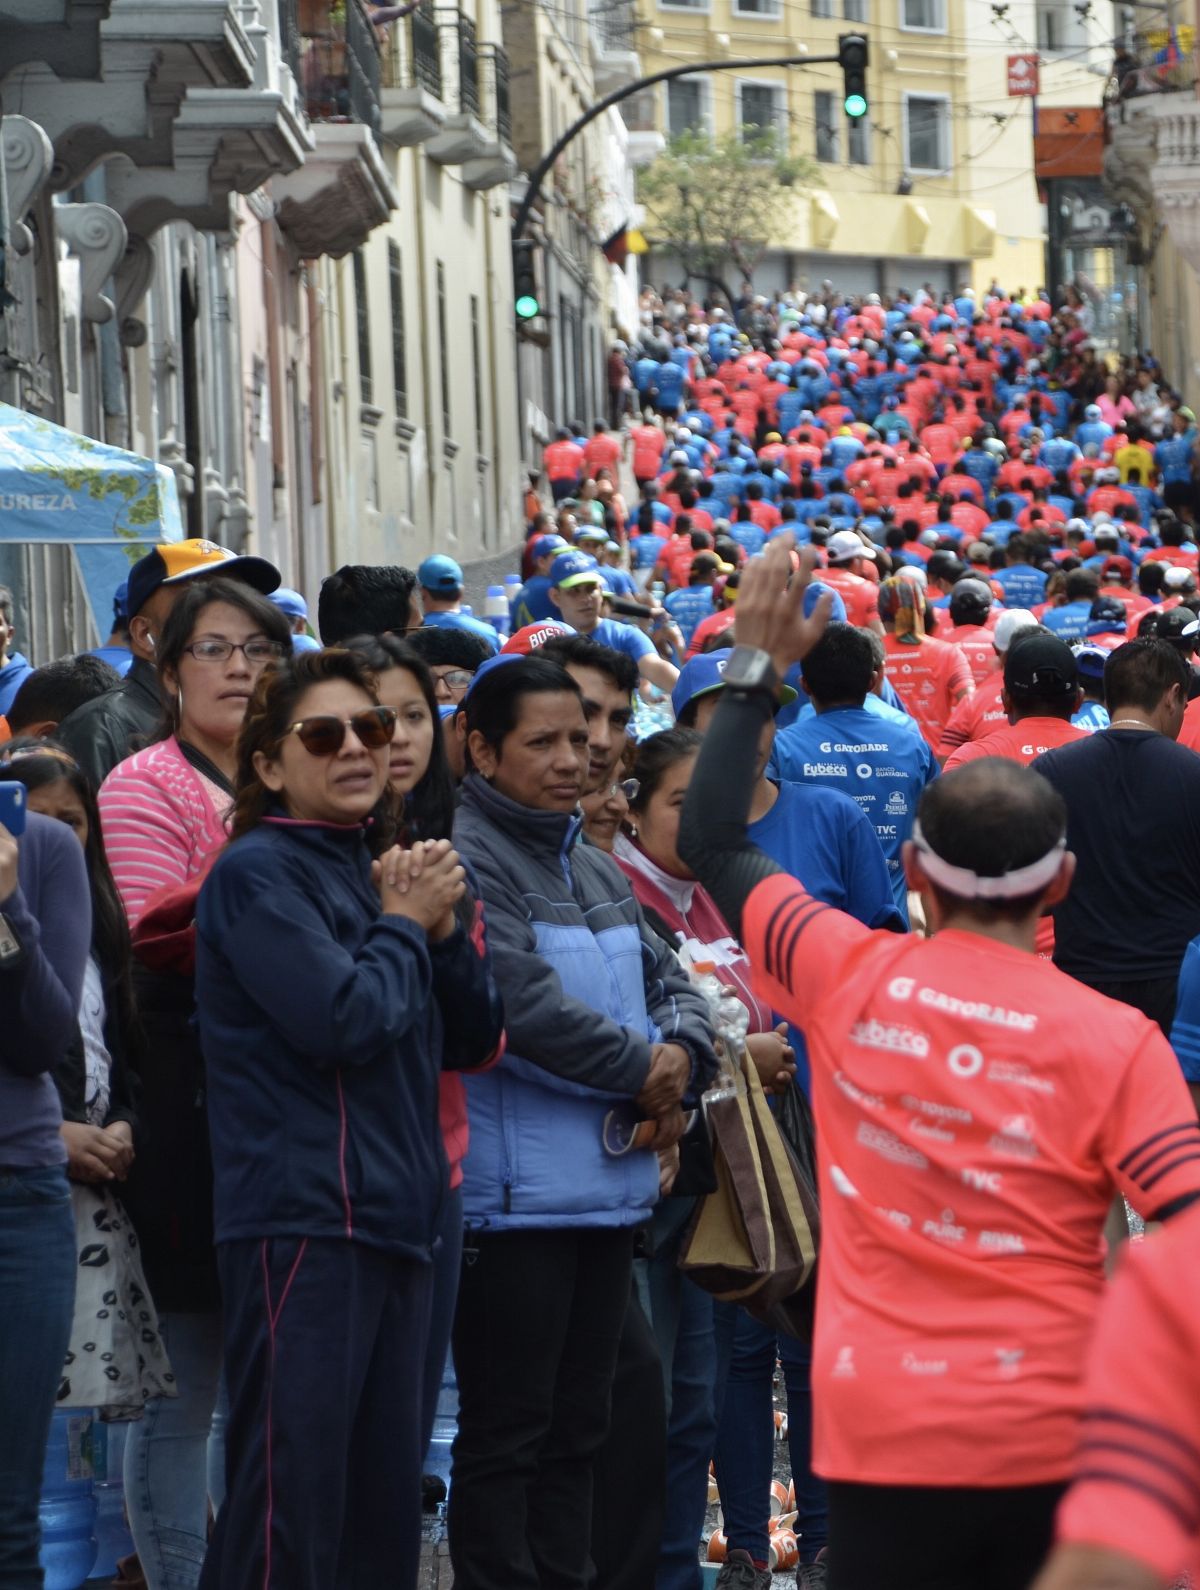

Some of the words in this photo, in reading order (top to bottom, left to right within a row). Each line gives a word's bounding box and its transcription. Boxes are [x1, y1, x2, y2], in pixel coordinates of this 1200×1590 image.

[834, 743, 889, 753] GATORADE
[803, 763, 848, 777] Fybeca
[877, 825, 897, 835] TVC
[917, 986, 1038, 1032] GATORADE
